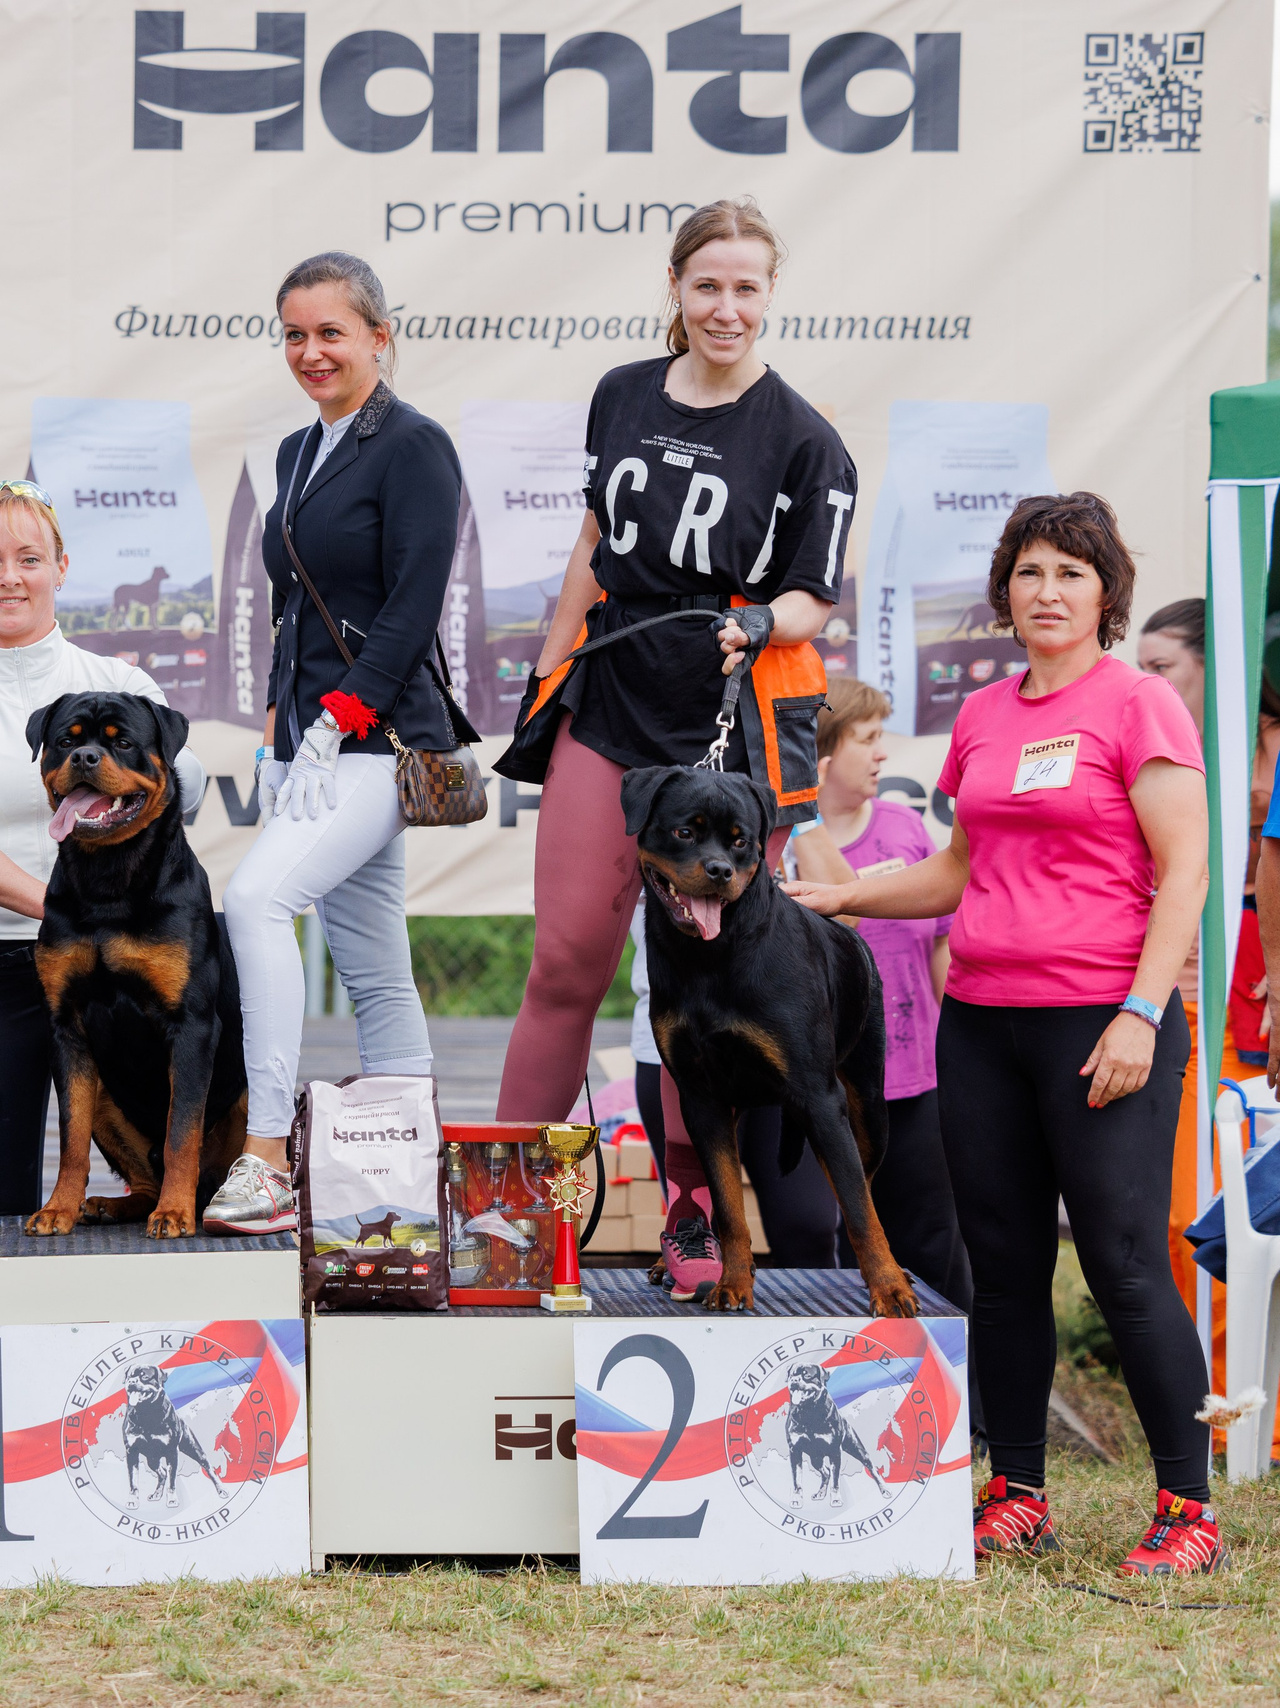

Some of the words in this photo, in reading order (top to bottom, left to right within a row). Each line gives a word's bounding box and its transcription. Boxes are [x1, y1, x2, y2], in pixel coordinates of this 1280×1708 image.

[132, 4, 962, 154] Hanta
[114, 305, 285, 348] Филосо
[780, 312, 972, 341] питания
[667, 453, 689, 466] LITTLE
[74, 488, 177, 509] Hanta
[503, 489, 586, 511] Hant
[233, 587, 255, 716] Hanta
[1025, 740, 1075, 757] Hanta
[333, 1126, 418, 1144] Hanta
[361, 1167, 390, 1176] PUPPY
[63, 1338, 144, 1490] РОТВЕЙЛЕР
[160, 1334, 232, 1368] КЛУБ
[237, 1372, 274, 1488] РОССИИ
[727, 1337, 806, 1489] РОТВЕЙЛЕР
[821, 1333, 894, 1368] КЛУБ
[900, 1372, 937, 1488] РОССИИ
[596, 1333, 710, 1540] 2
[117, 1506, 232, 1544] РКФ-НКПР
[780, 1506, 897, 1543] РКФ-НКПР
